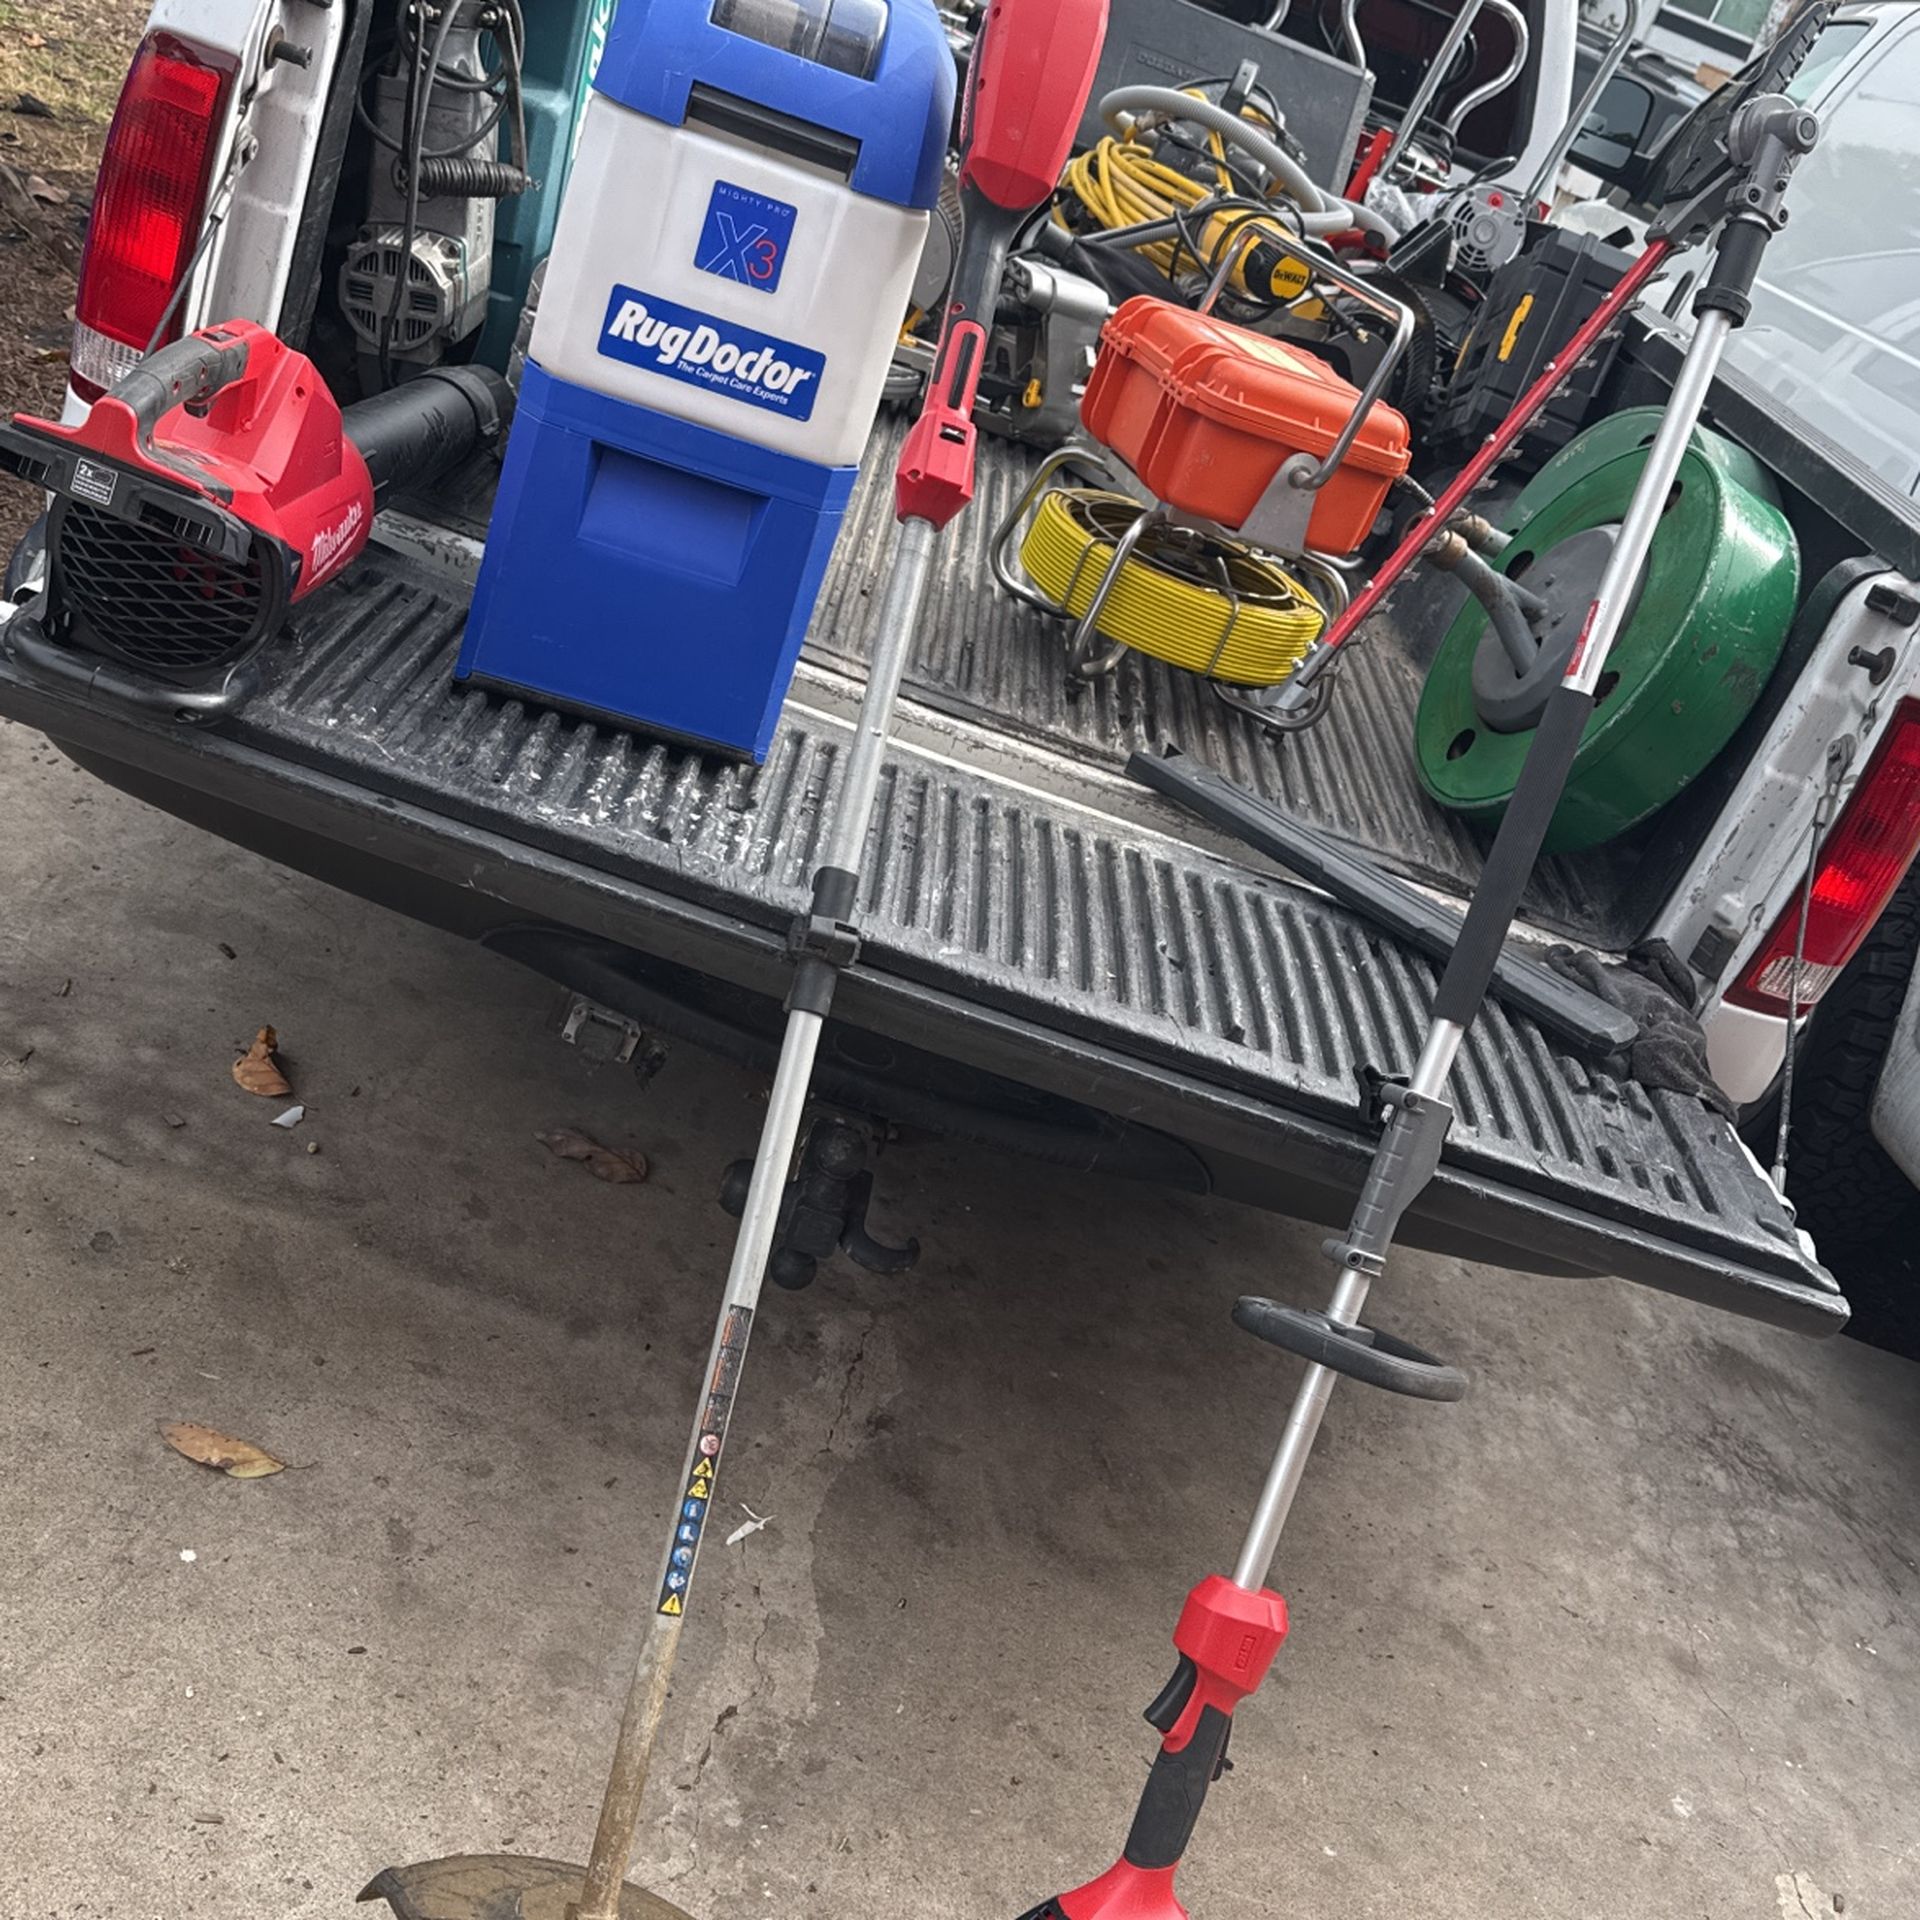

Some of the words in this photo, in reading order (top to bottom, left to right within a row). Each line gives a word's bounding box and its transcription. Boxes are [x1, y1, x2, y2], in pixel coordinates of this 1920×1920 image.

[719, 186, 761, 207] MIGHTY
[703, 211, 778, 286] X3
[608, 300, 811, 394] RugDoctor
[677, 360, 695, 374] The
[695, 367, 730, 385] Carpet
[729, 378, 753, 393] Care
[753, 386, 789, 406] Experts
[310, 501, 363, 573] Milwaukee
